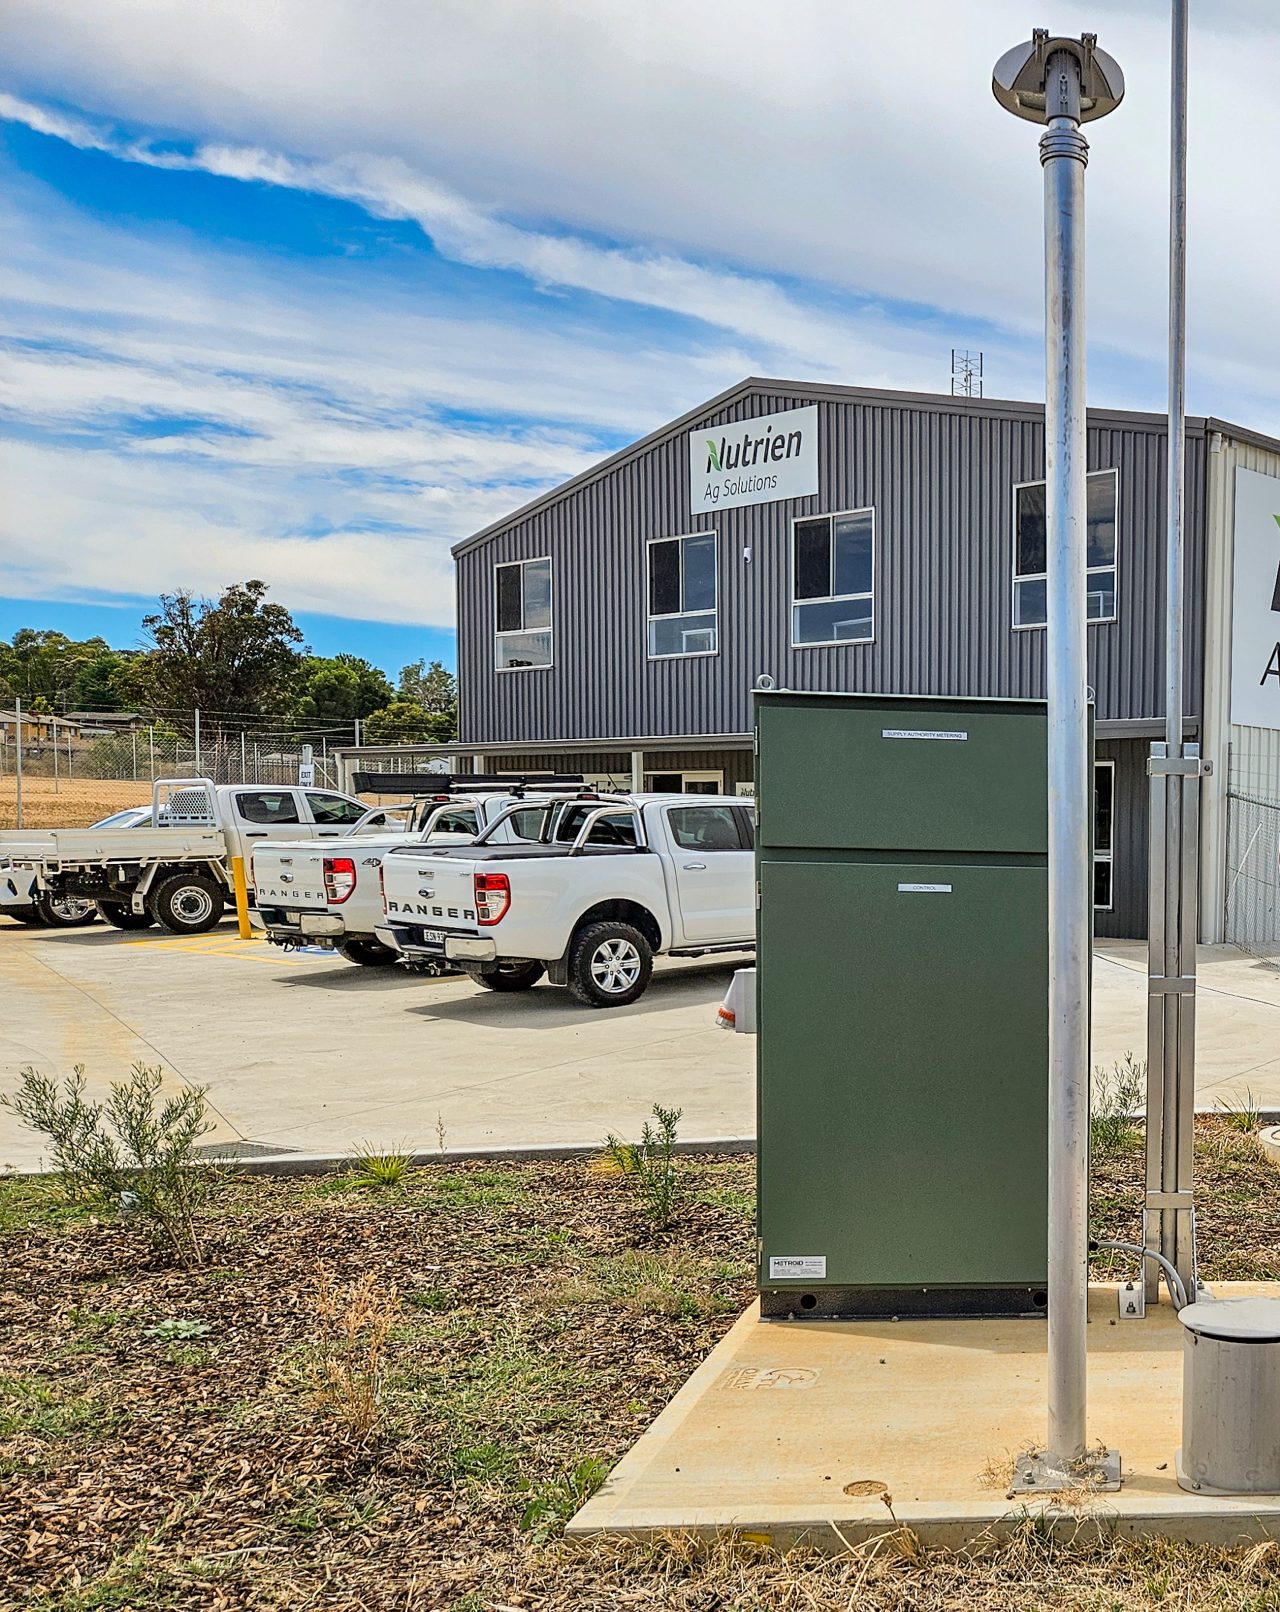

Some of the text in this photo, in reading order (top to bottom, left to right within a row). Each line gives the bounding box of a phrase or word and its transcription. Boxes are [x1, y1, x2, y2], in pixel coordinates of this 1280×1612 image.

[705, 425, 802, 474] Nutrien
[704, 475, 777, 503] Ag Solutions
[301, 771, 311, 779] EXIT
[259, 888, 324, 899] RANGER
[388, 901, 476, 920] RANGER
